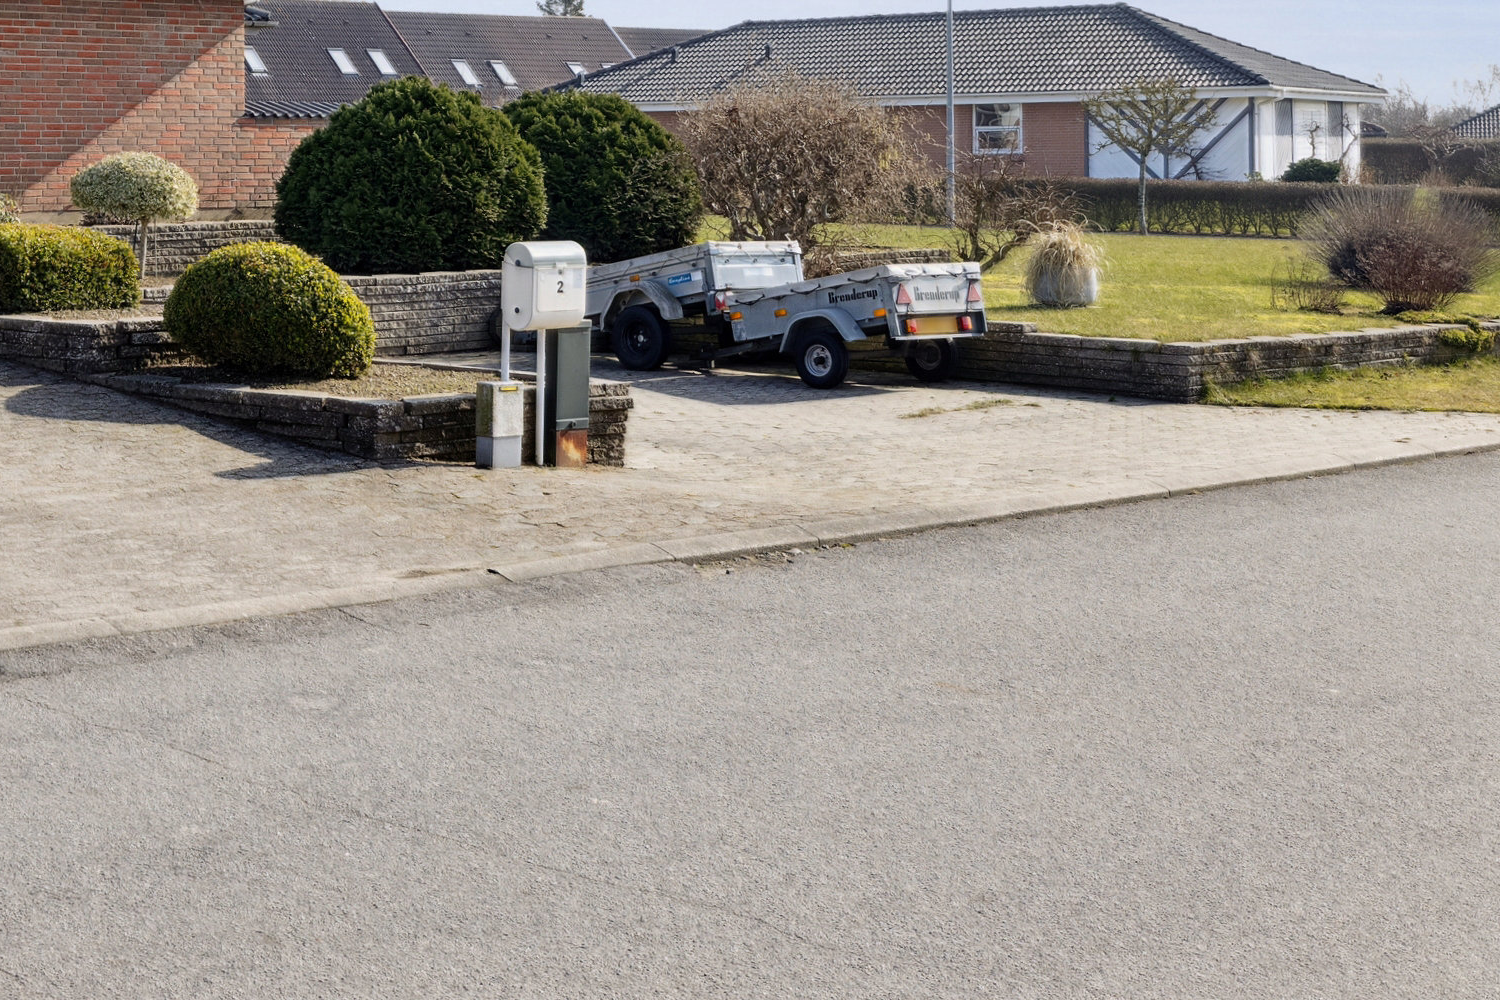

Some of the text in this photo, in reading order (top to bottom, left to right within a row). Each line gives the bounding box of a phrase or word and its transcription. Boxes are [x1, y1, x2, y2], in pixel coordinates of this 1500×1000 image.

[556, 280, 564, 293] 2
[913, 284, 960, 303] Brenderup
[828, 288, 878, 304] Brenderup
